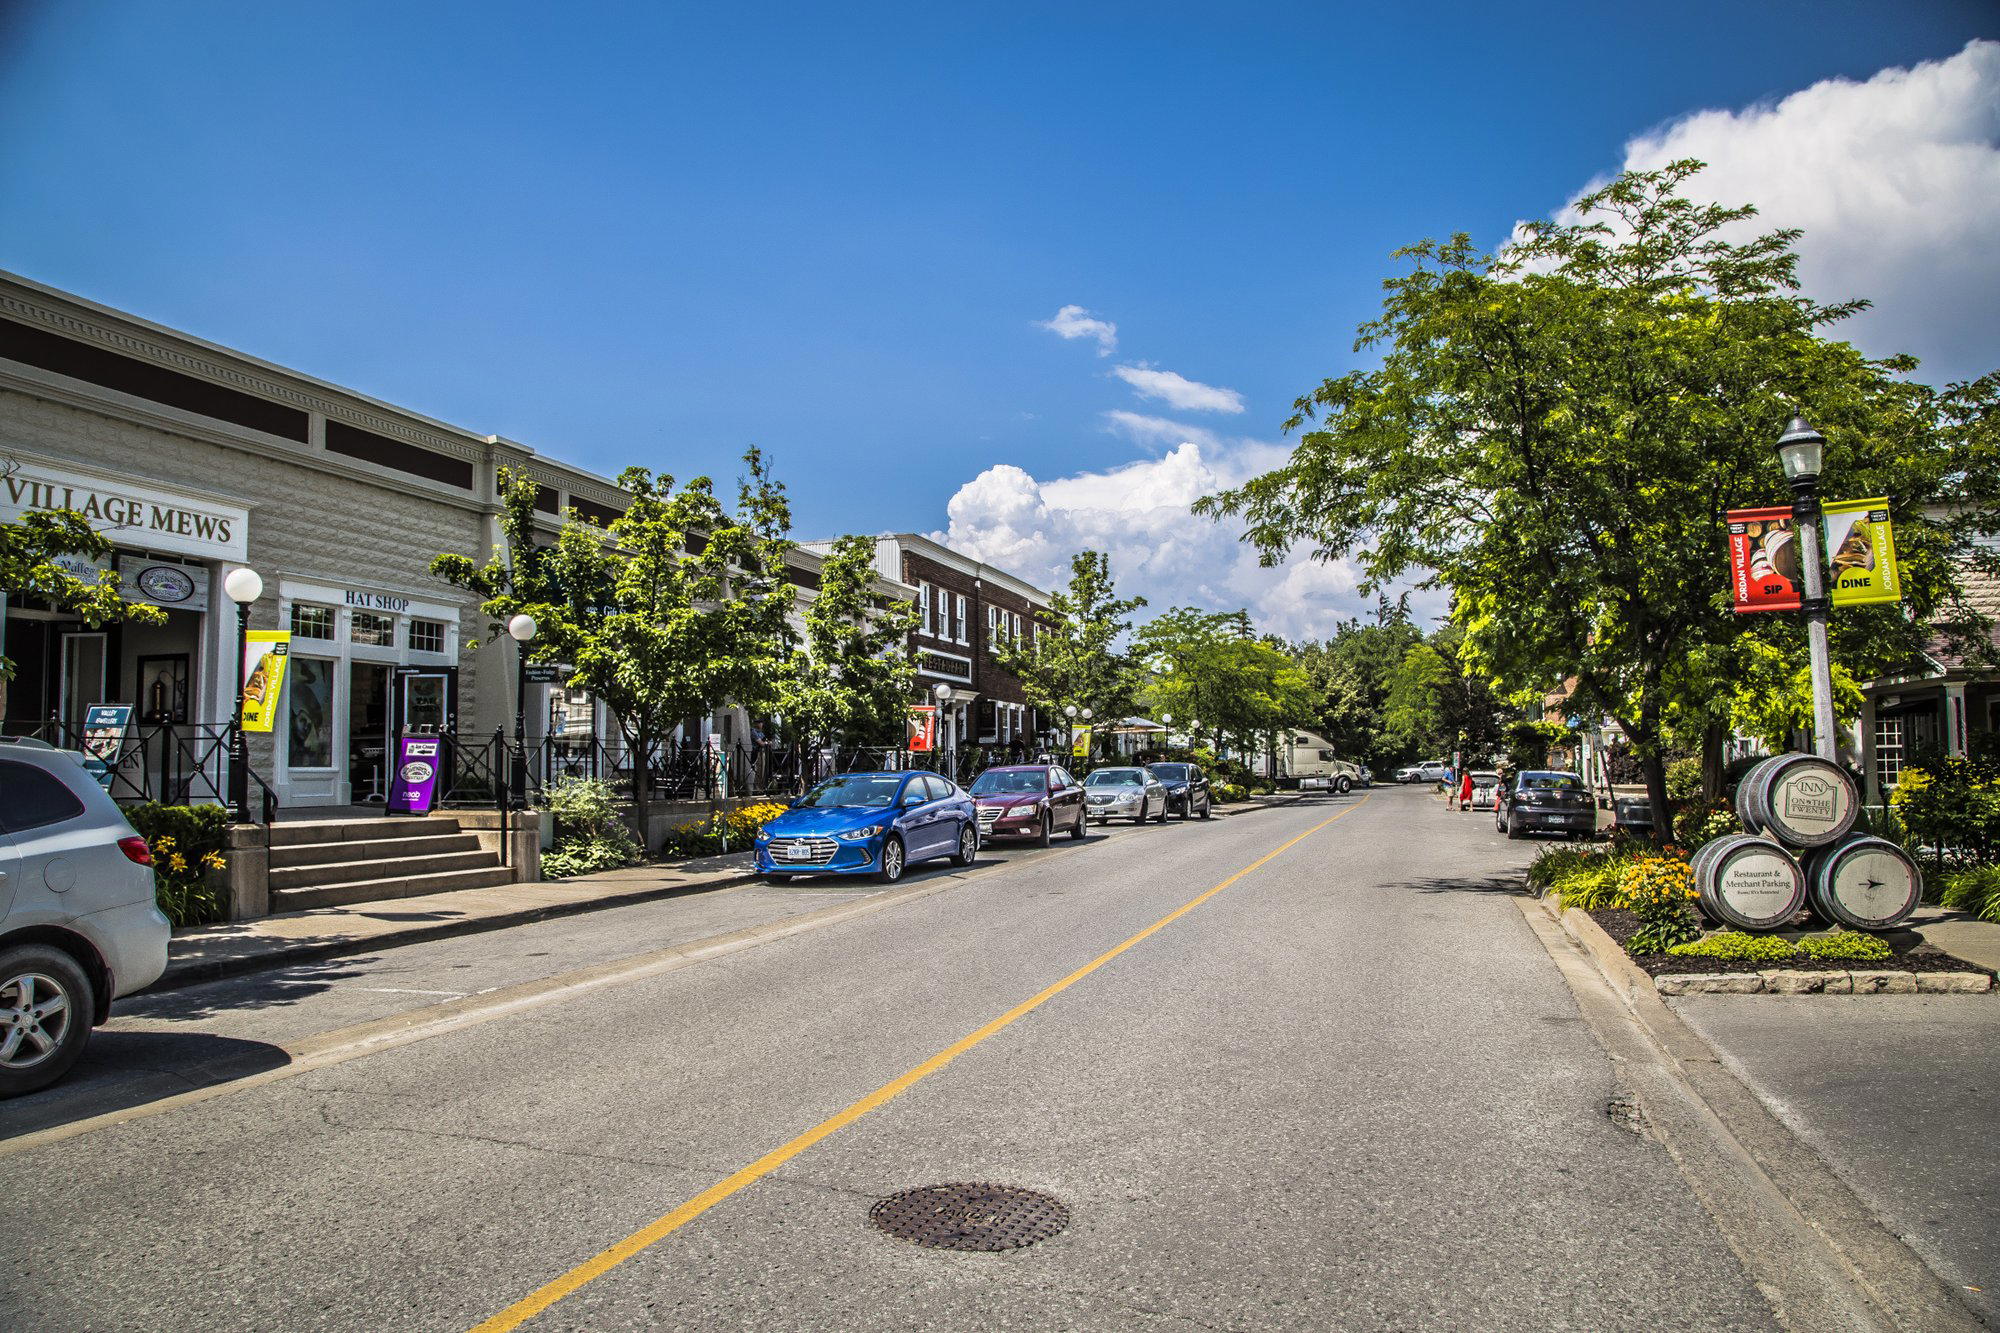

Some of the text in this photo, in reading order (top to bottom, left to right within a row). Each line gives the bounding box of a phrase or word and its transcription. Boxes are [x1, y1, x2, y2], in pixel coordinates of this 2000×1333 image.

[7, 476, 231, 543] VILLAGE MEWS
[1875, 524, 1887, 557] VILLAGE
[1734, 536, 1745, 569] VILLAGE
[1881, 558, 1893, 591] JORDAN
[1736, 570, 1748, 603] JORDAN
[1763, 584, 1783, 595] SIP
[1841, 577, 1872, 589] DINE
[346, 591, 410, 612] HAT SHOP
[263, 692, 274, 728] JORDAN
[270, 657, 282, 689] VILLAGE
[1800, 782, 1824, 792] INN
[1791, 797, 1831, 807] ON THE
[1792, 805, 1831, 815] TWENTY
[1733, 870, 1773, 878] Restaurant
[1726, 880, 1791, 889] Merchant Parking
